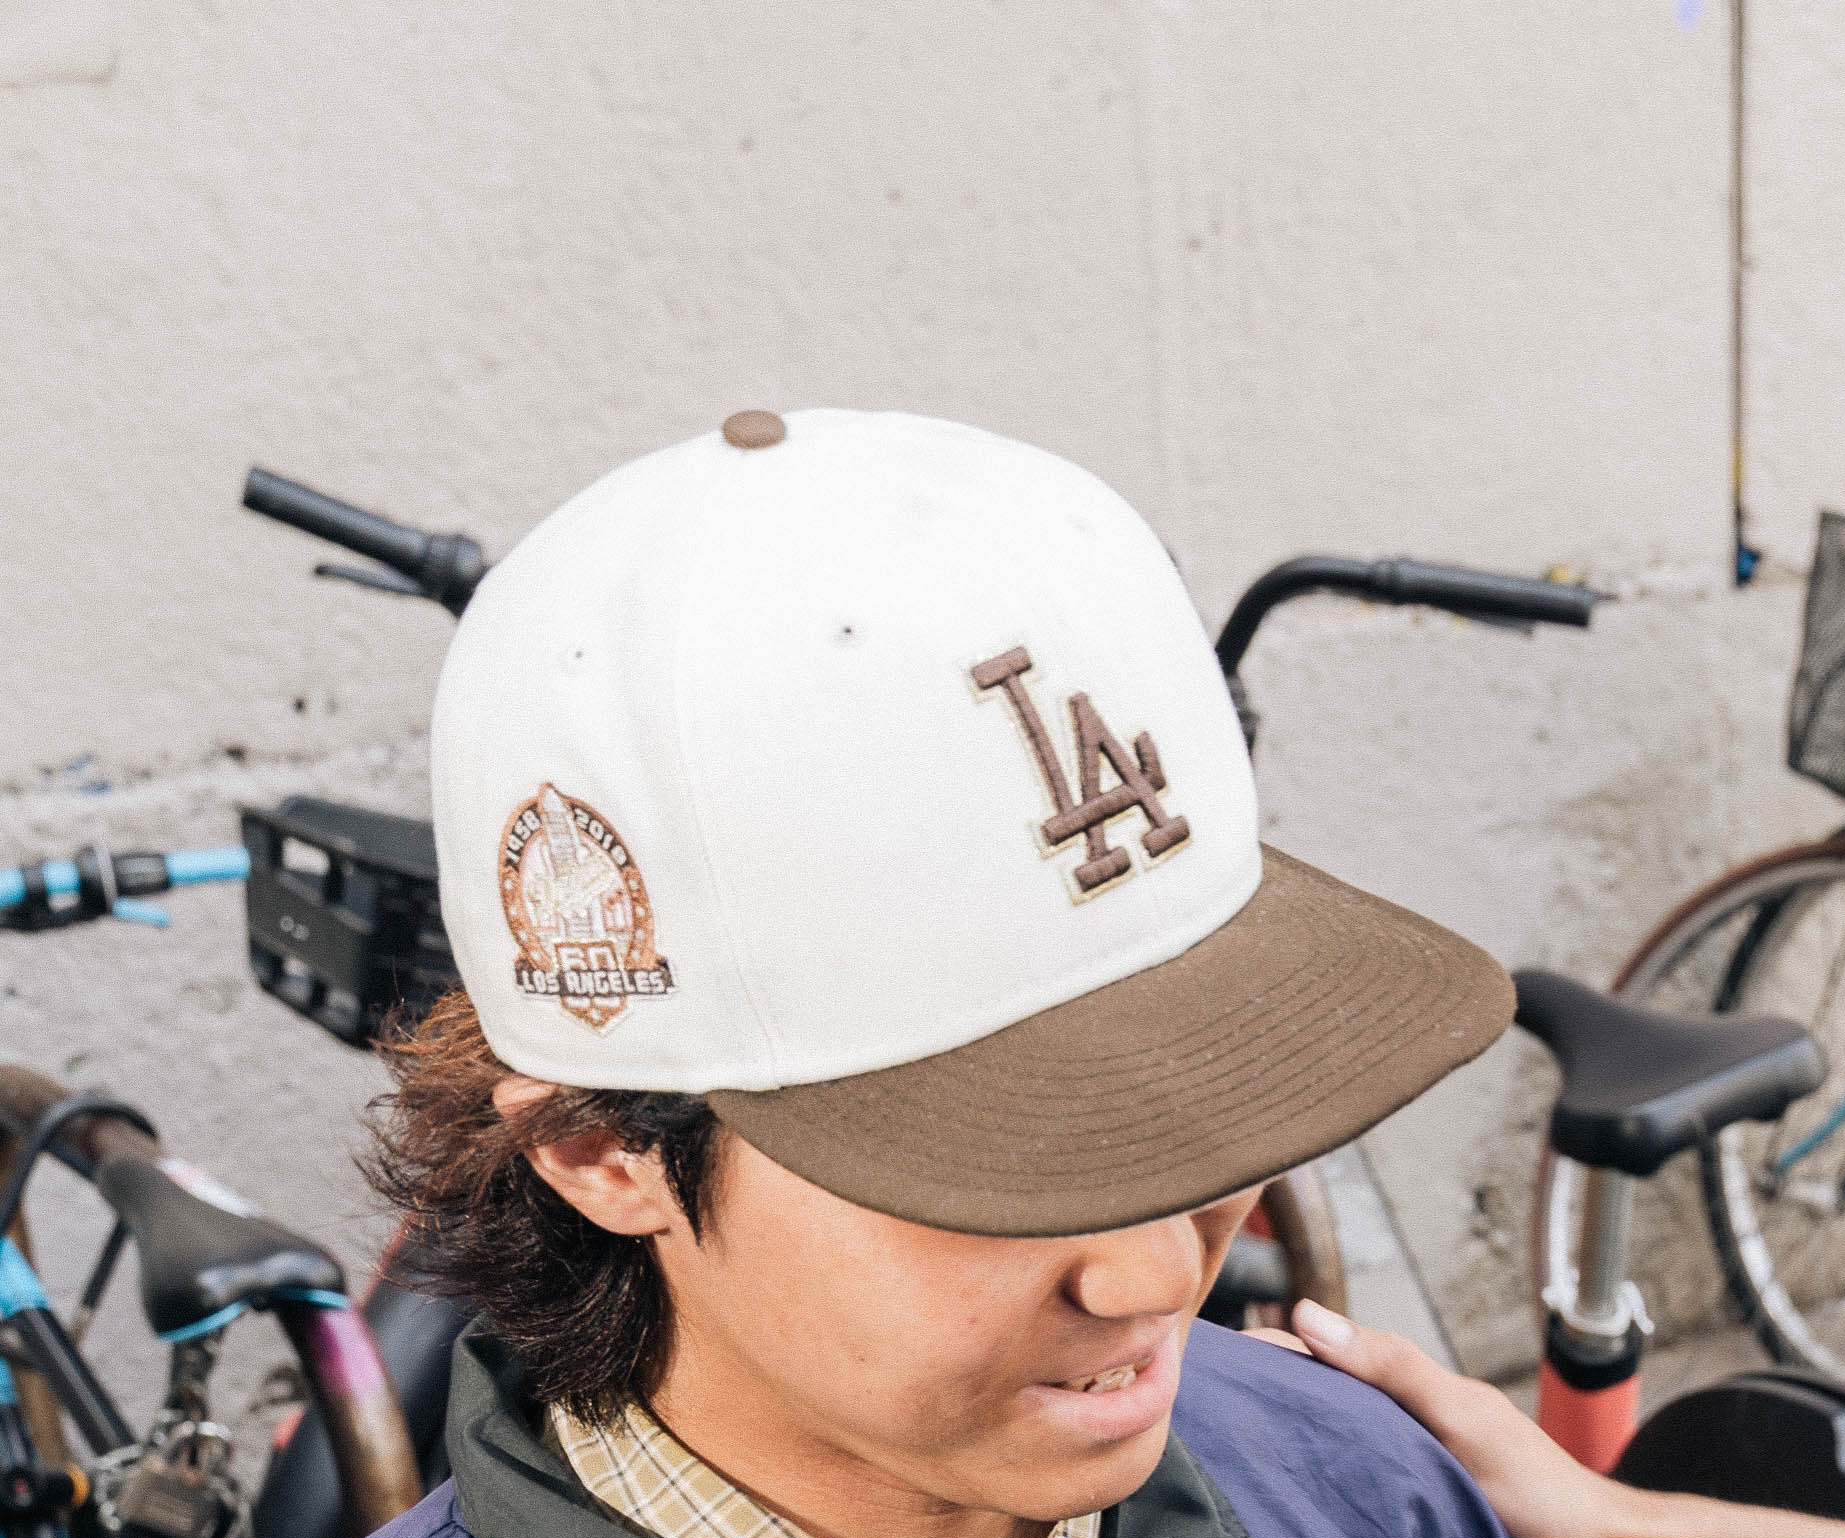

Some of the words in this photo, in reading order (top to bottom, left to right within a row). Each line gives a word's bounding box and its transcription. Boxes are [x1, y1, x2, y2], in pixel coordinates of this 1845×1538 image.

[969, 645, 1191, 895] LA
[520, 968, 561, 993] LOS
[565, 968, 668, 995] ANGELES
